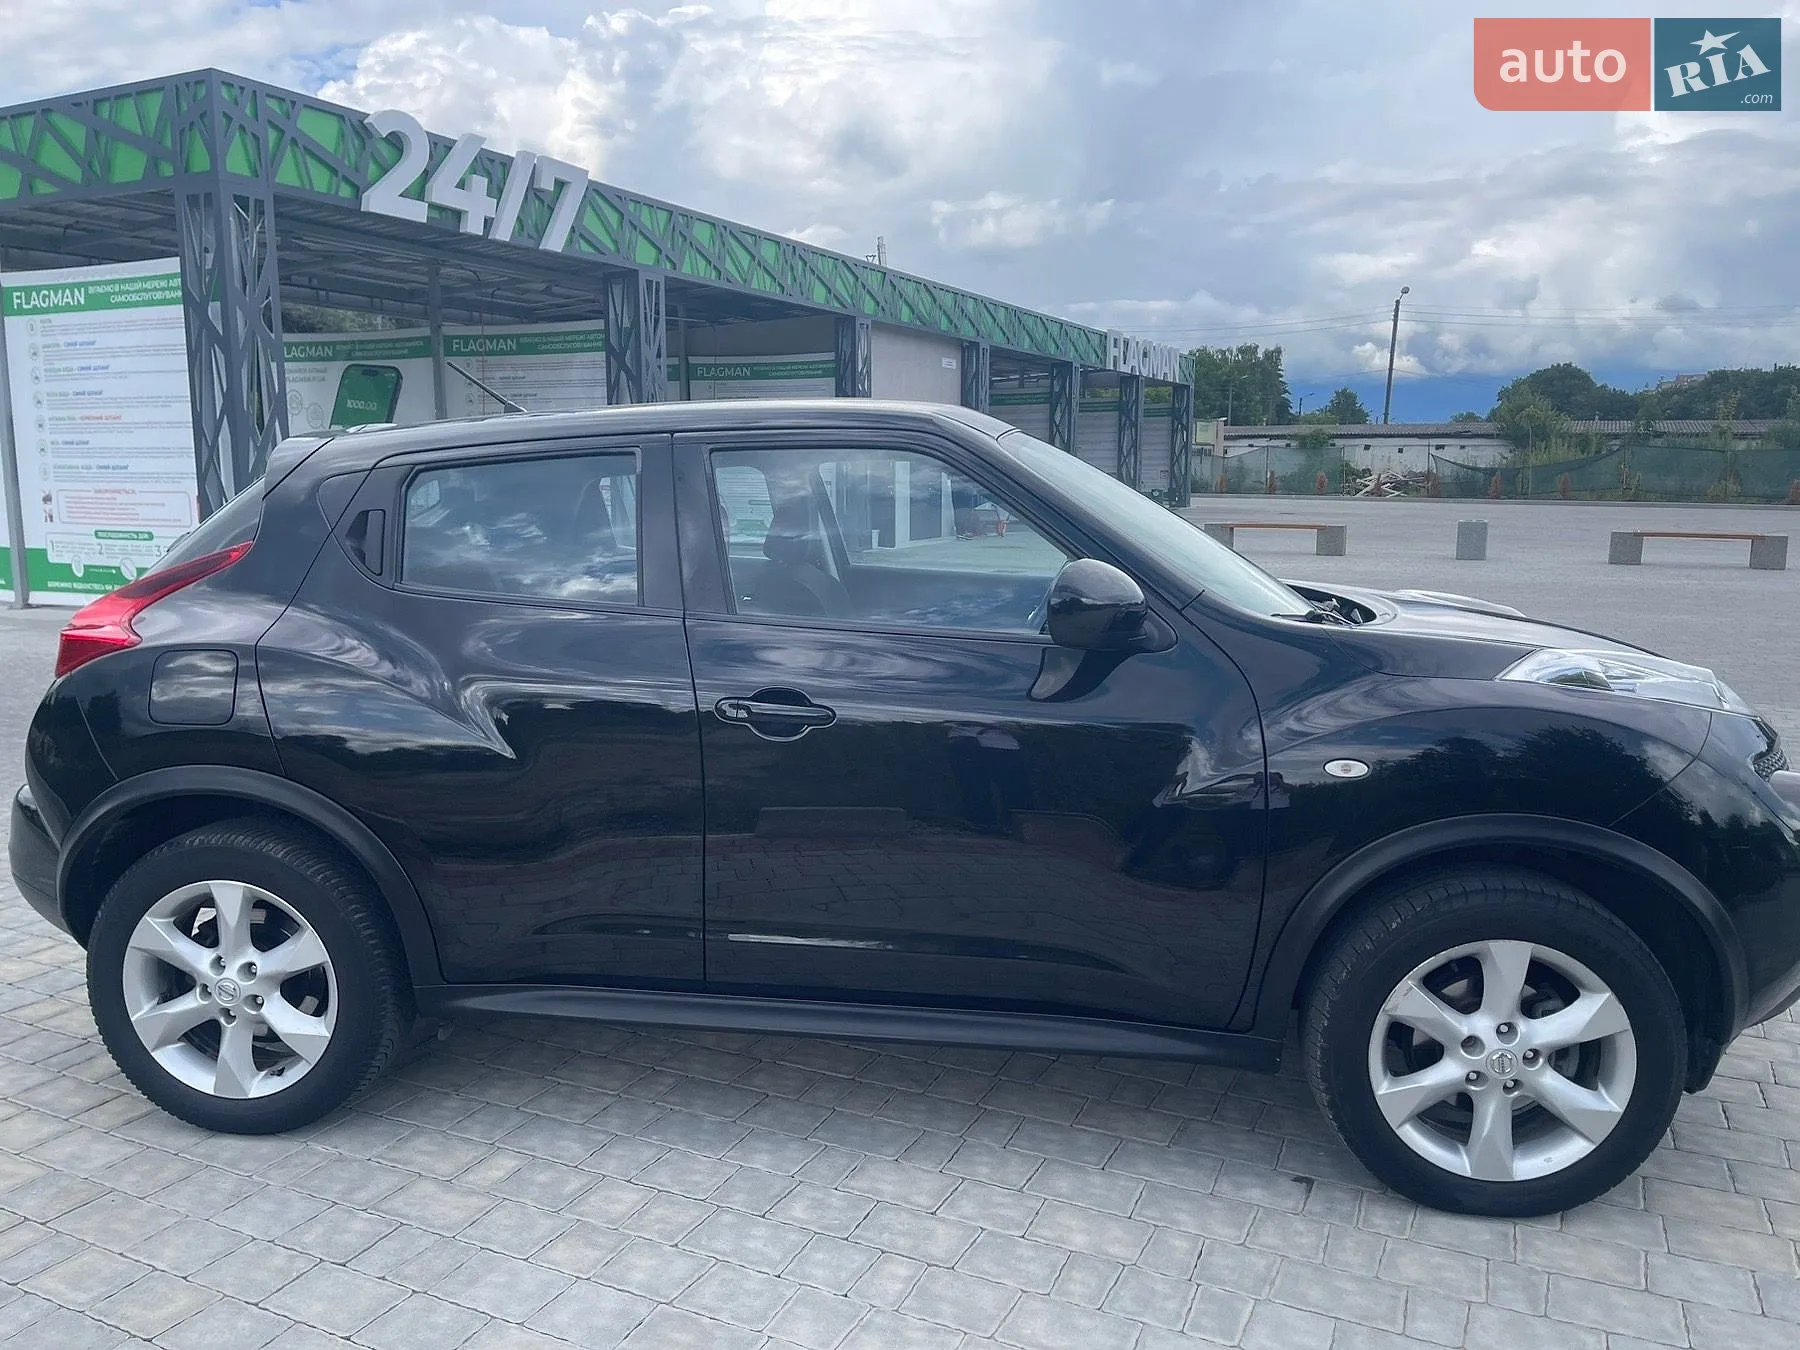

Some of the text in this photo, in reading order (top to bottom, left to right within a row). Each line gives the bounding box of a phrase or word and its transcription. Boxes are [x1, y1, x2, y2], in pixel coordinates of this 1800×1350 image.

[361, 109, 589, 252] 24/7
[12, 287, 85, 310] FLAGMAN
[284, 345, 333, 358] LAGMAN
[452, 337, 517, 352] FLAGMAN
[1107, 329, 1180, 382] FLAGMAN
[697, 366, 751, 378] FLAGMAN
